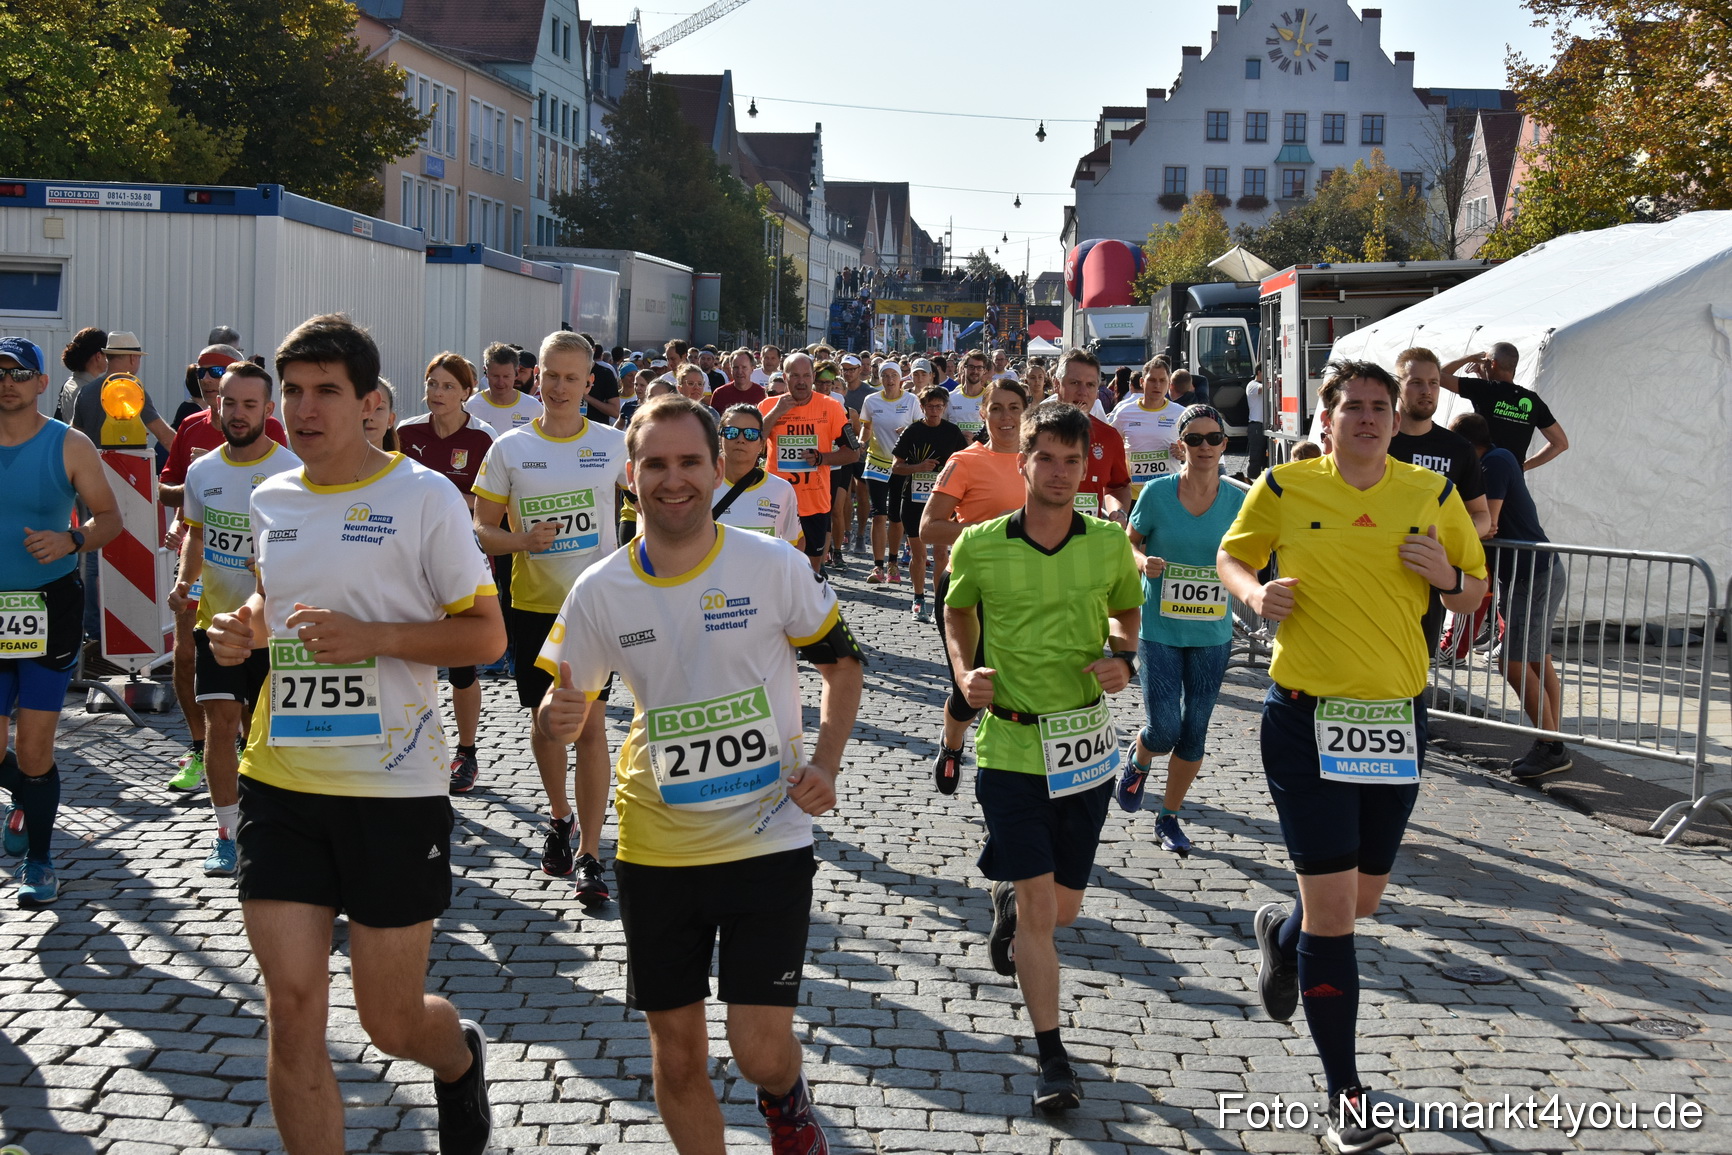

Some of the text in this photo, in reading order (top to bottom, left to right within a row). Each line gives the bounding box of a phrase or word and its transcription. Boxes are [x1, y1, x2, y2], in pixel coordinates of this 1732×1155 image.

[911, 304, 949, 314] START
[1495, 400, 1518, 411] physio
[1494, 408, 1529, 420] neumarkt
[787, 424, 814, 435] RUN
[779, 437, 814, 445] BOCK
[579, 449, 592, 457] 20
[781, 448, 814, 459] 283
[1133, 451, 1166, 460] BOCK
[1135, 462, 1166, 473] 2780
[525, 492, 589, 514] BOCK
[348, 508, 369, 521] 20
[344, 524, 397, 535] Neumarkter
[531, 512, 591, 536] 70
[268, 529, 298, 539] BOCK
[342, 534, 384, 545] Stadtlauf
[209, 528, 254, 554] 2671
[1171, 583, 1220, 602] 1061
[703, 594, 748, 610] 20 JAHRE
[704, 608, 758, 621] Neumarkter
[1172, 605, 1214, 614] DANIELA
[705, 619, 748, 632] Stadtlauf
[619, 629, 655, 645] BOCK
[0, 642, 38, 650] FGANG
[282, 676, 365, 708] 2755
[655, 692, 764, 737] BOCK
[1323, 701, 1406, 721] BOCK
[306, 720, 332, 732] Luis
[385, 753, 406, 771] 14./15.
[404, 721, 423, 754] September
[1055, 725, 1113, 768] 2040
[1327, 726, 1405, 754] 2059
[665, 729, 766, 777] 2709
[1072, 760, 1111, 784] ANDRE
[1336, 761, 1398, 774] MARCEL
[700, 774, 762, 797] Christoph
